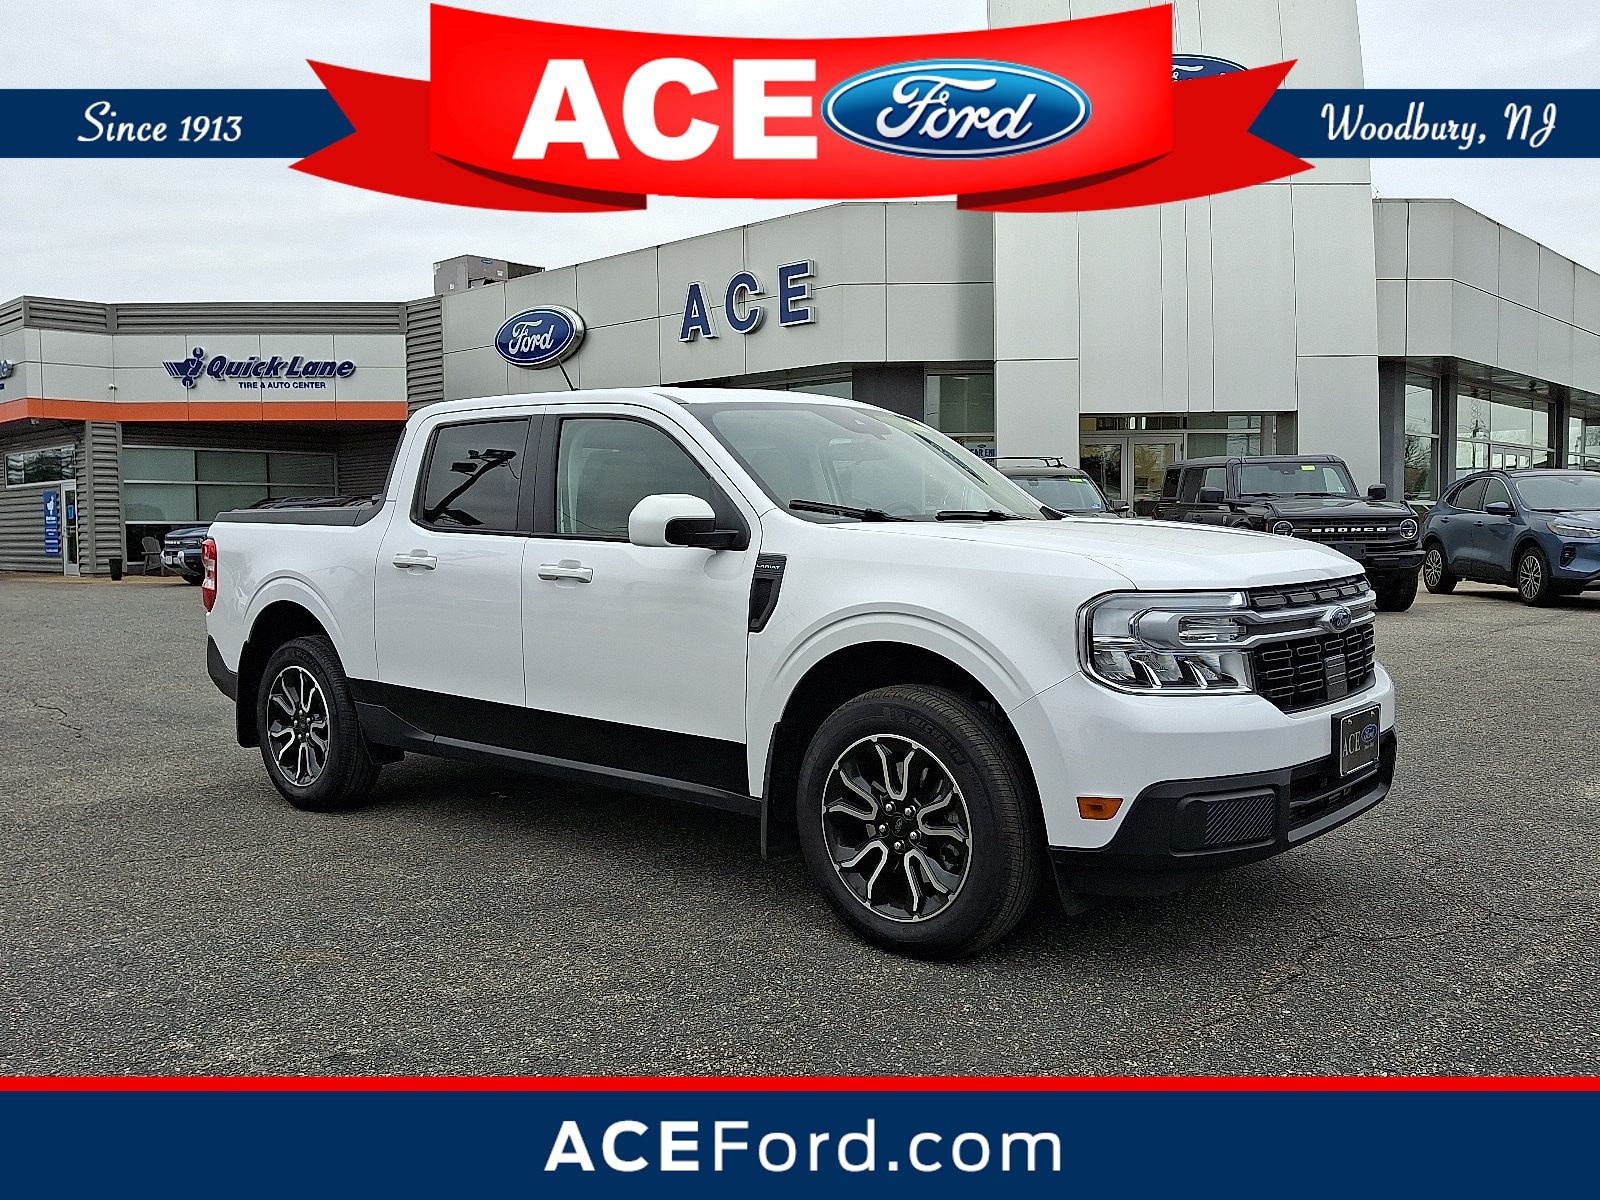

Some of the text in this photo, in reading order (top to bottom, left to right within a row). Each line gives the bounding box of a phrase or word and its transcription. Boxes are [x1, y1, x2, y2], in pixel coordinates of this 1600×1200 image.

[678, 259, 816, 342] ACE
[508, 319, 555, 355] Ford
[206, 355, 356, 381] Quick Lane
[238, 381, 258, 389] TIRE
[267, 381, 291, 389] AUTO
[292, 381, 326, 389] CENTER
[1342, 730, 1361, 757] ACE
